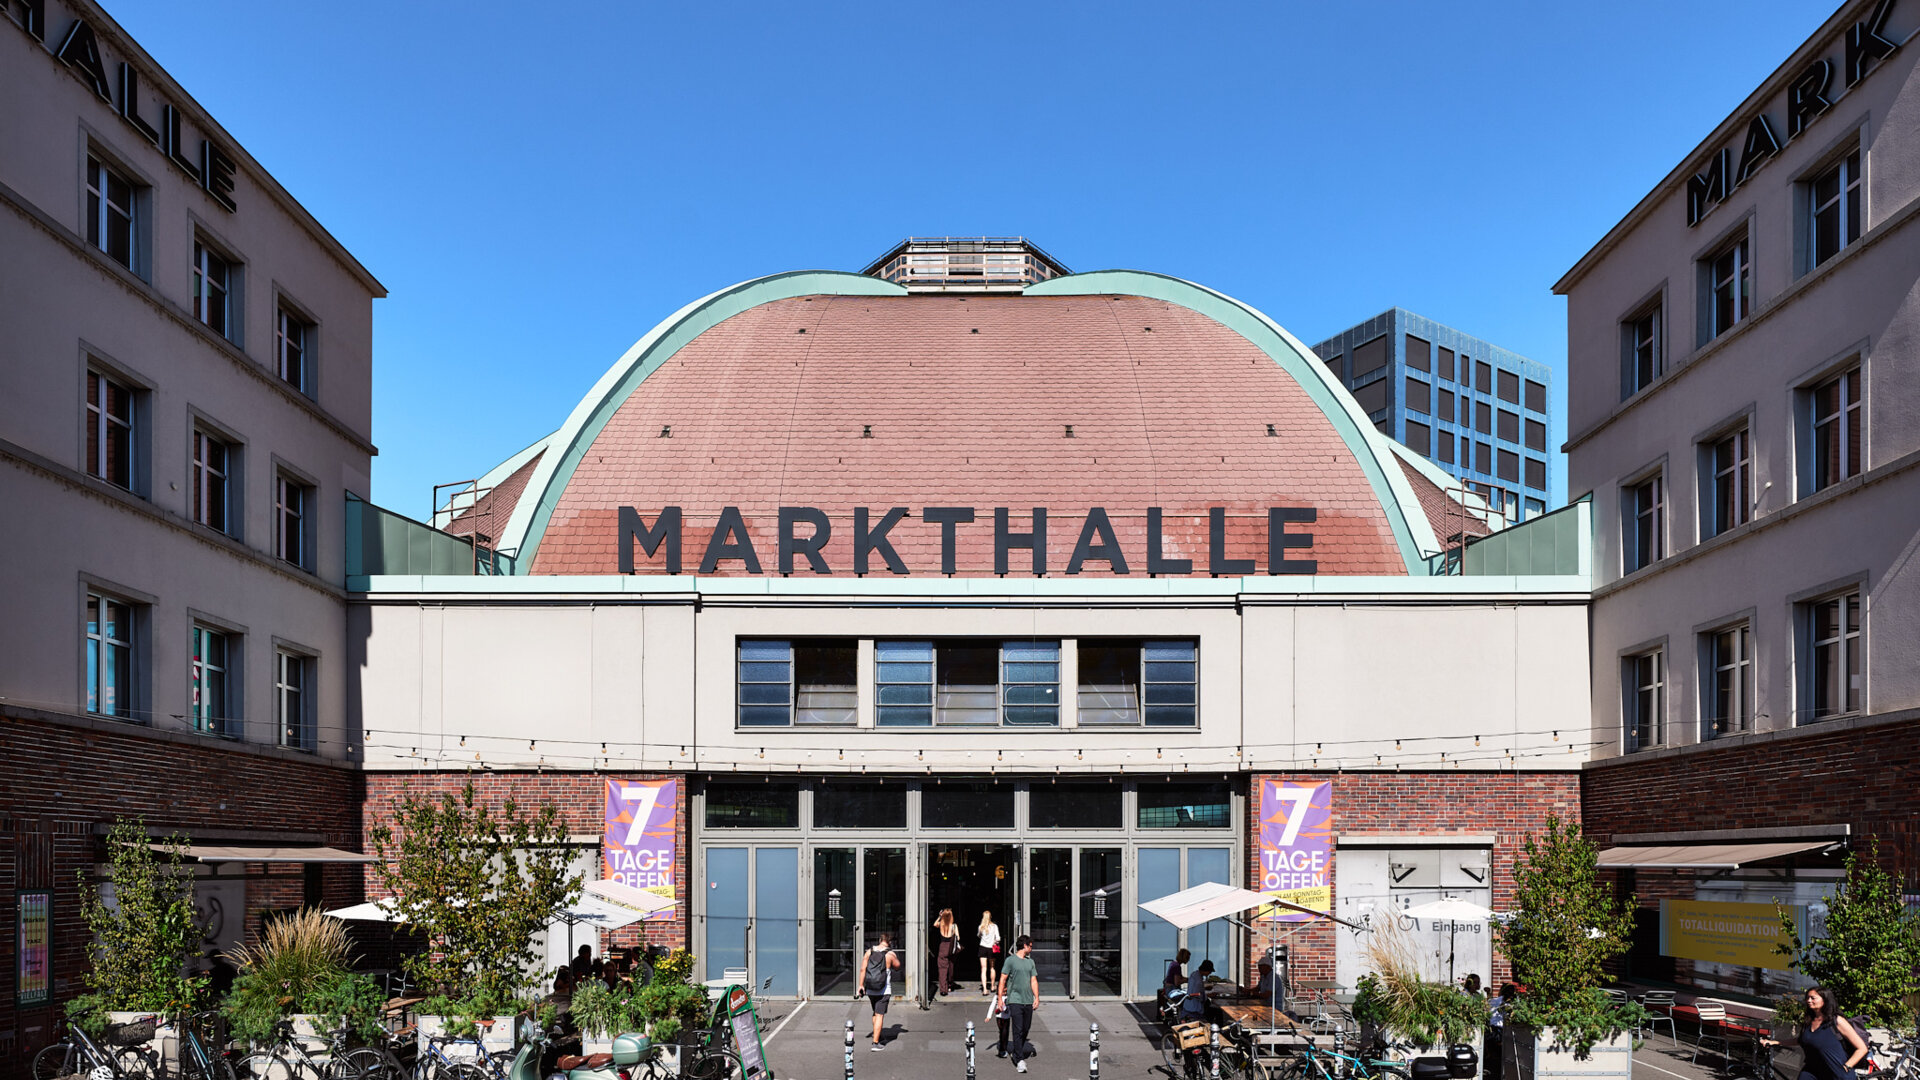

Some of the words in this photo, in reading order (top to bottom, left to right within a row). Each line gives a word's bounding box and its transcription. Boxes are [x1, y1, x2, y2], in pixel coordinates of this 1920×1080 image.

[1687, 0, 1897, 228] MARK
[618, 506, 1317, 574] MARKTHALLE
[621, 787, 660, 846] 7
[1275, 788, 1316, 846] 7
[611, 849, 670, 871] TAGE
[1264, 850, 1324, 871] TAGE
[1264, 872, 1324, 889] OFFEN
[1432, 921, 1481, 934] Eingang
[1679, 918, 1779, 937] TOTALLIQUIDATION
